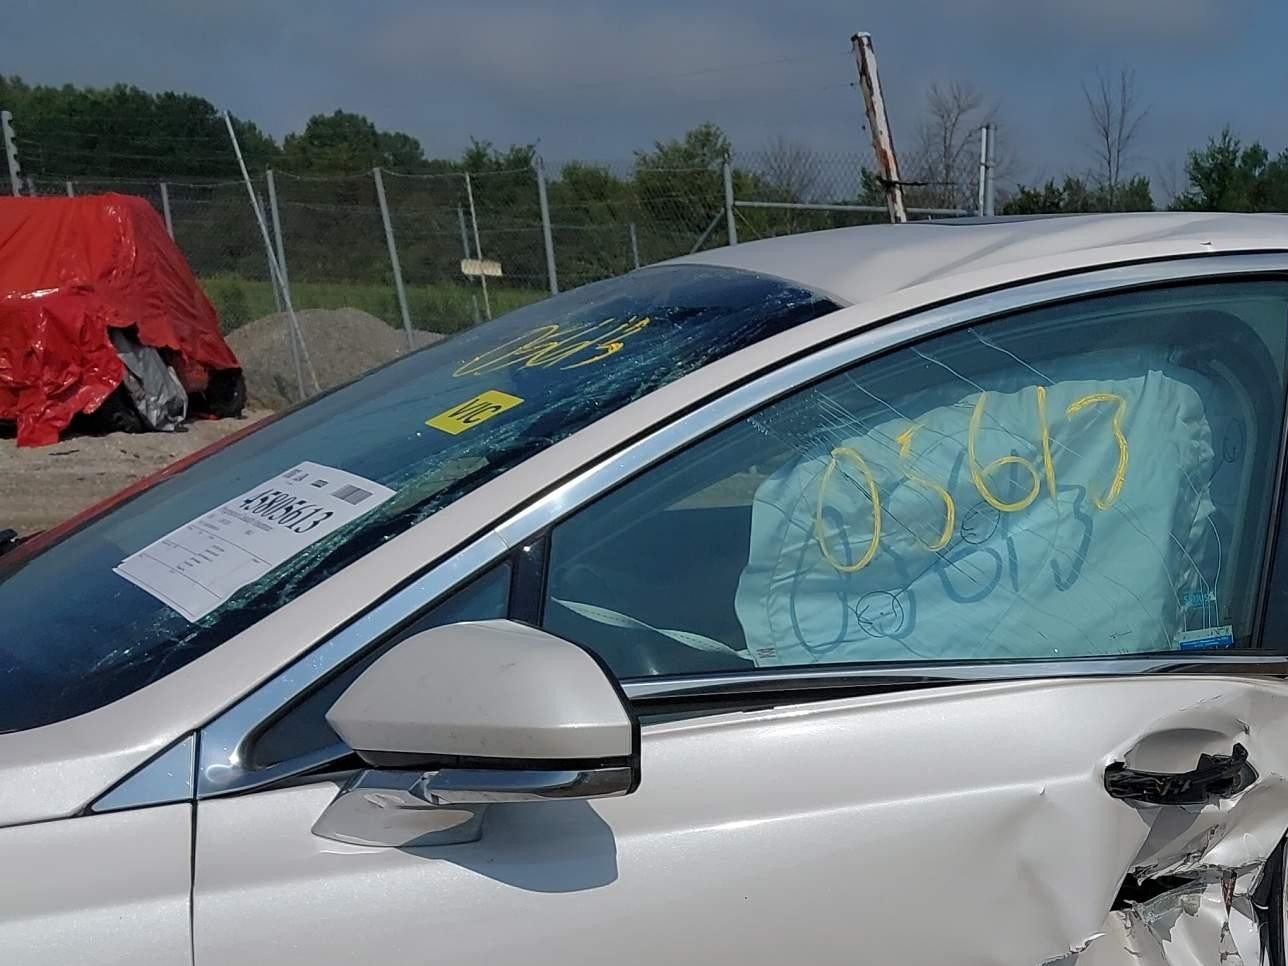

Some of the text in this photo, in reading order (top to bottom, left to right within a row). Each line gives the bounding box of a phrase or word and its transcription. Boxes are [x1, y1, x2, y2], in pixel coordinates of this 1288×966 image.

[448, 398, 502, 424] VIC
[816, 384, 1129, 573] 05613
[239, 488, 334, 533] 45805613
